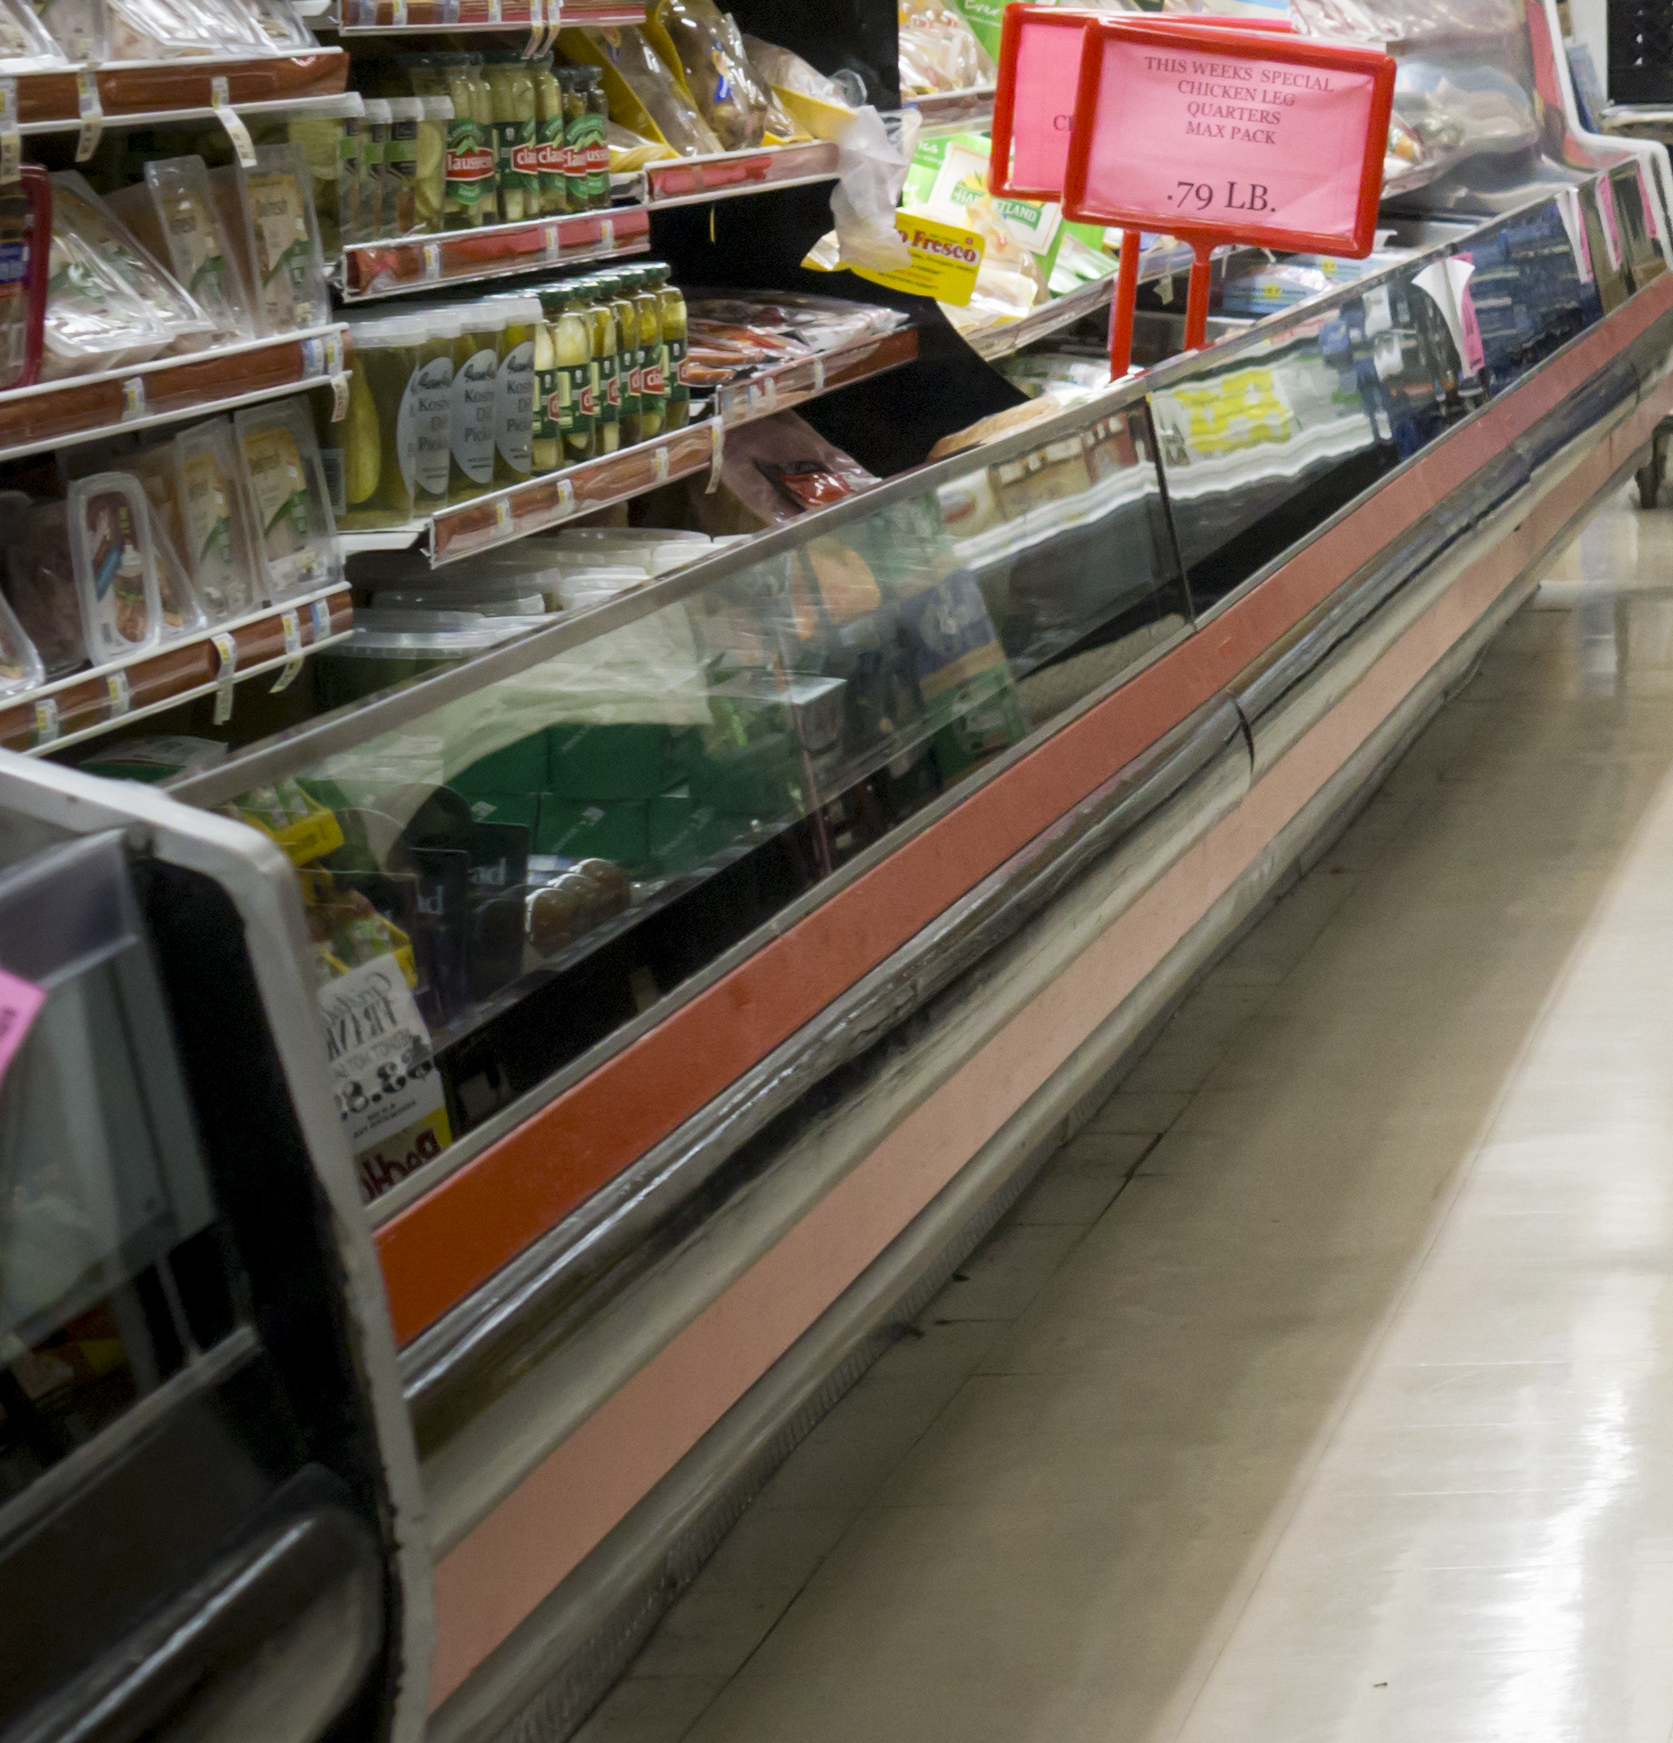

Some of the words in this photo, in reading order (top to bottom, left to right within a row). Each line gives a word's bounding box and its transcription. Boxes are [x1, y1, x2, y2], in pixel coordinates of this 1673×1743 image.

[1144, 56, 1187, 73] THIS
[1191, 60, 1254, 81] WEEKS
[1260, 68, 1334, 92] SPECIAL
[1178, 79, 1257, 102] CHICKEN
[1261, 89, 1296, 107] LEG
[1187, 100, 1281, 125] QUARTERS
[1185, 120, 1226, 139] MAX
[1230, 125, 1277, 145] PACK
[1166, 181, 1214, 211] .79
[1225, 181, 1277, 212] LB.
[911, 228, 978, 264] Fresco
